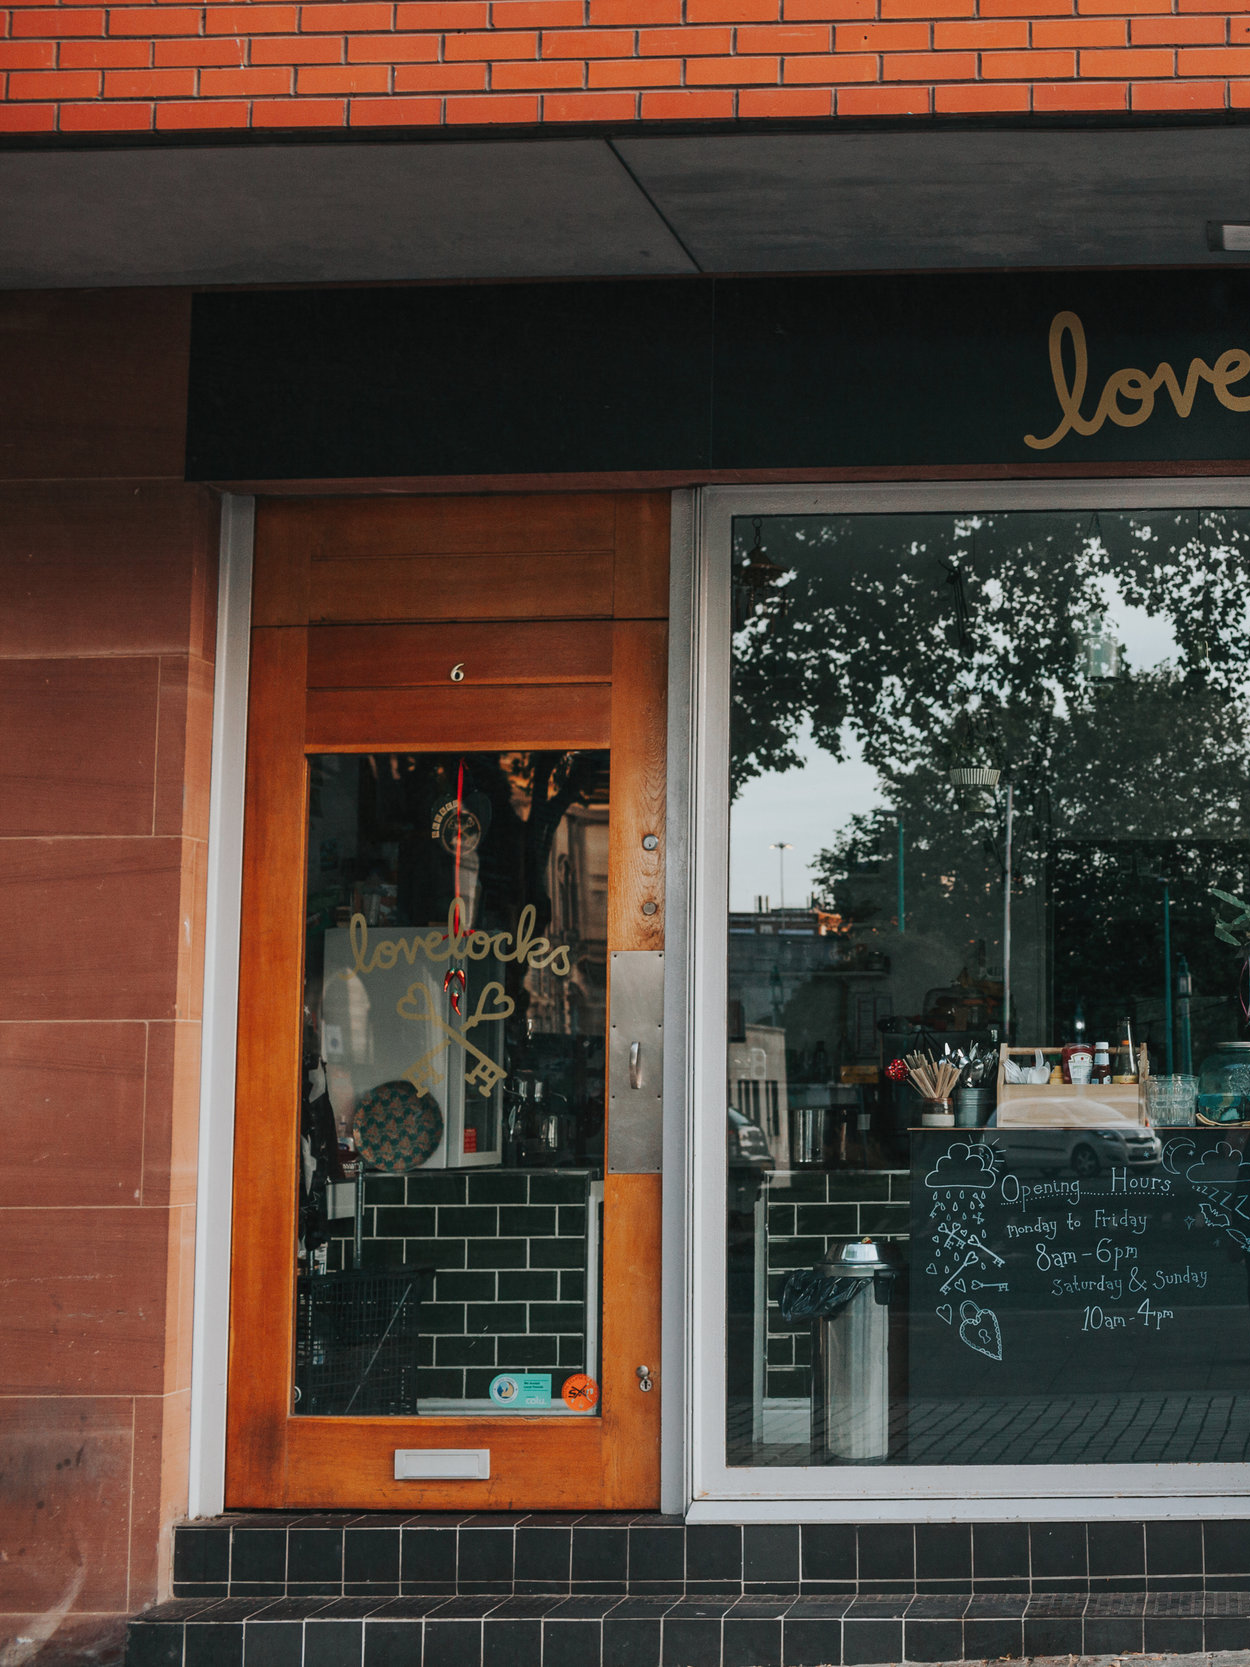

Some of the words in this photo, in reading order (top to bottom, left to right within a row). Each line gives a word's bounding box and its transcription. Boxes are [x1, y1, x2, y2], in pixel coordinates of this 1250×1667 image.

[450, 663, 465, 682] 6
[339, 897, 570, 976] lovelocks
[1001, 1174, 1081, 1213] Opening
[1111, 1166, 1172, 1192] Hours
[1067, 1212, 1081, 1231] to
[1094, 1208, 1148, 1235] Friday
[1051, 1274, 1123, 1300] Saturday
[1128, 1266, 1148, 1293] &
[1152, 1265, 1208, 1290] Sunday
